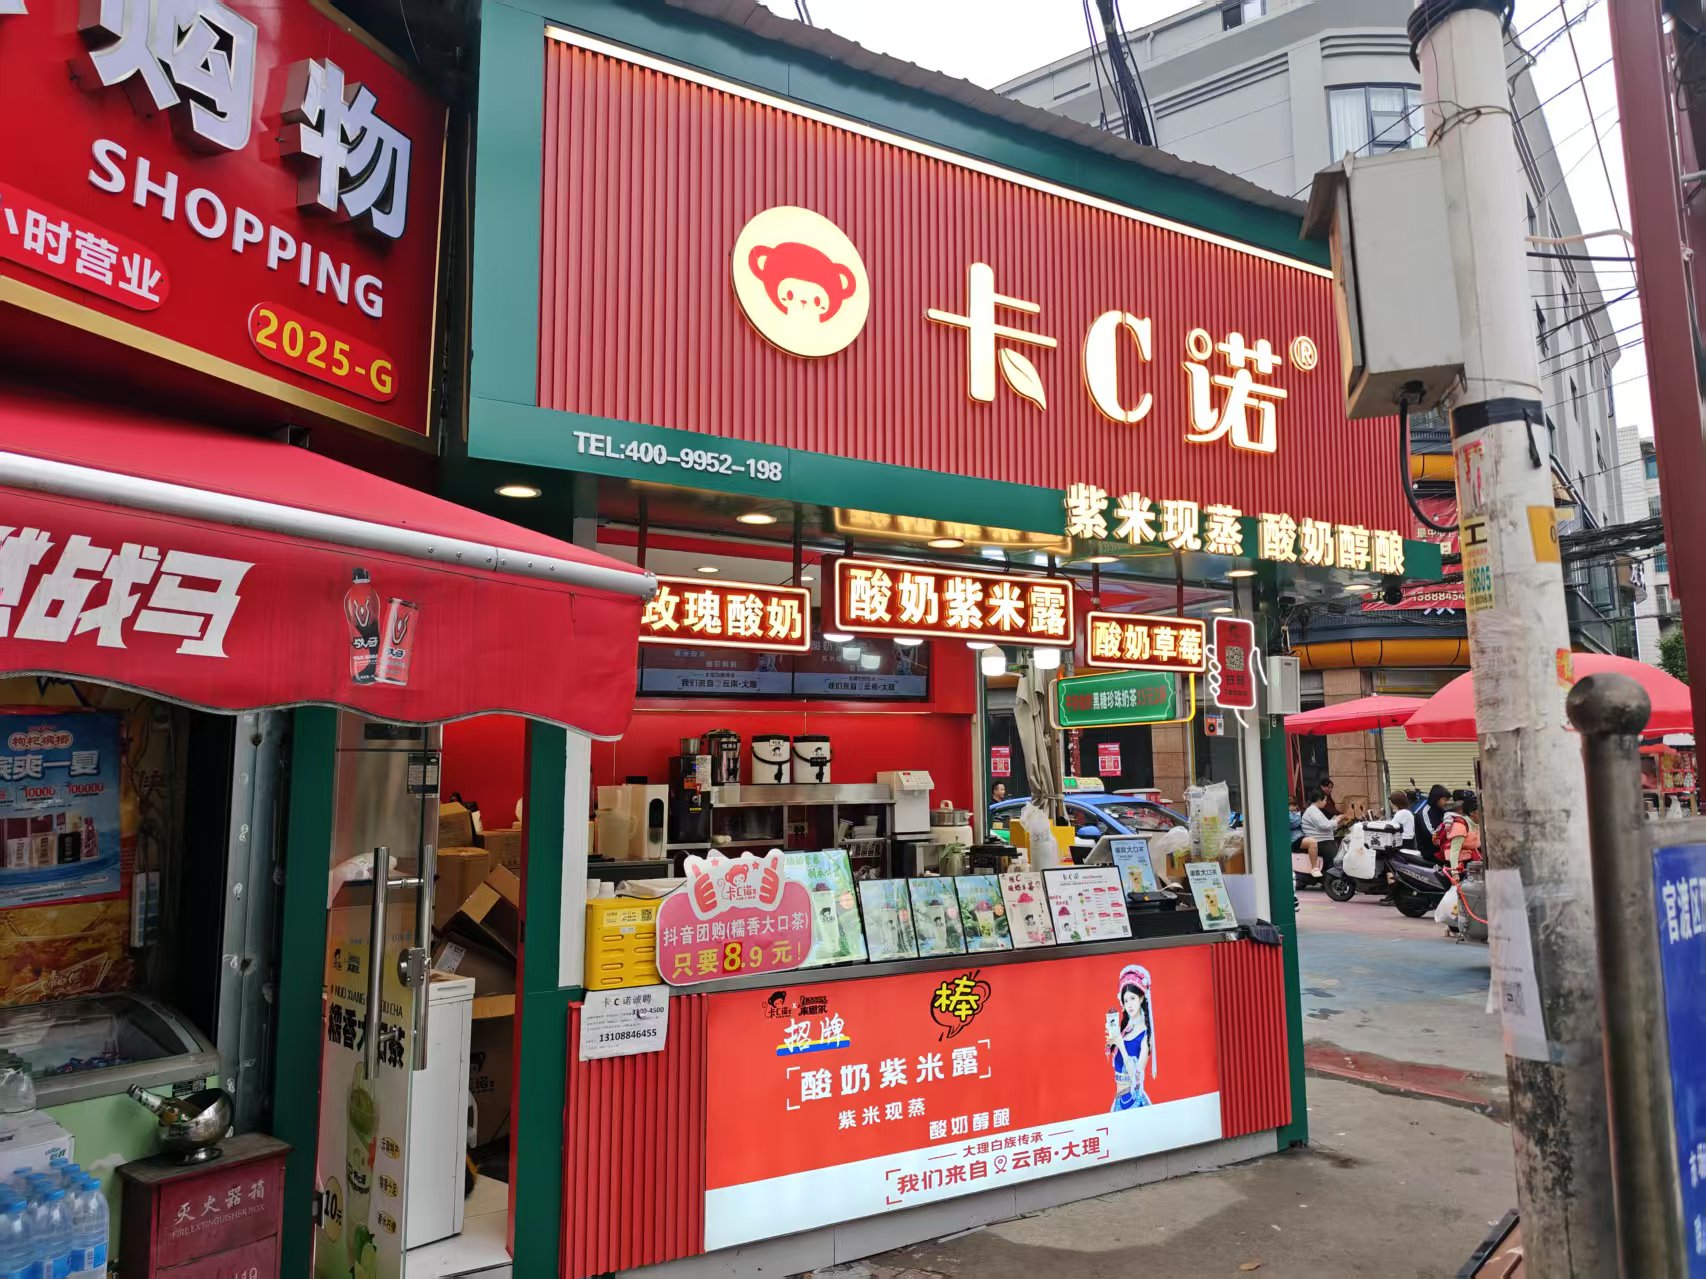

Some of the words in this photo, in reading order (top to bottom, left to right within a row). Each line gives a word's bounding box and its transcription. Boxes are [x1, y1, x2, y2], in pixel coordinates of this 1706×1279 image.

[88, 138, 384, 318] SHOPPING
[255, 308, 393, 395] 2025-G
[572, 430, 783, 483] TEL:400-9952-198
[1062, 482, 1244, 556] 紫米现蒸
[1256, 511, 1405, 576] 酸奶醇酿
[849, 568, 1067, 636] 酸奶紫米露
[1091, 620, 1203, 664] 酸奶草莓
[663, 911, 809, 946] 抖音团购(糯香大口茶)
[934, 976, 987, 1022] 棒
[599, 1028, 657, 1043] 13108846455
[800, 1045, 979, 1102] 酸奶紫米露
[838, 1097, 927, 1130] 紫米现蒸
[896, 1158, 988, 1196] 我们来自
[1011, 1137, 1102, 1170] 云南·大理
[962, 1130, 1043, 1159] 大理白族传承
[175, 1179, 265, 1225] 灭火器箱
